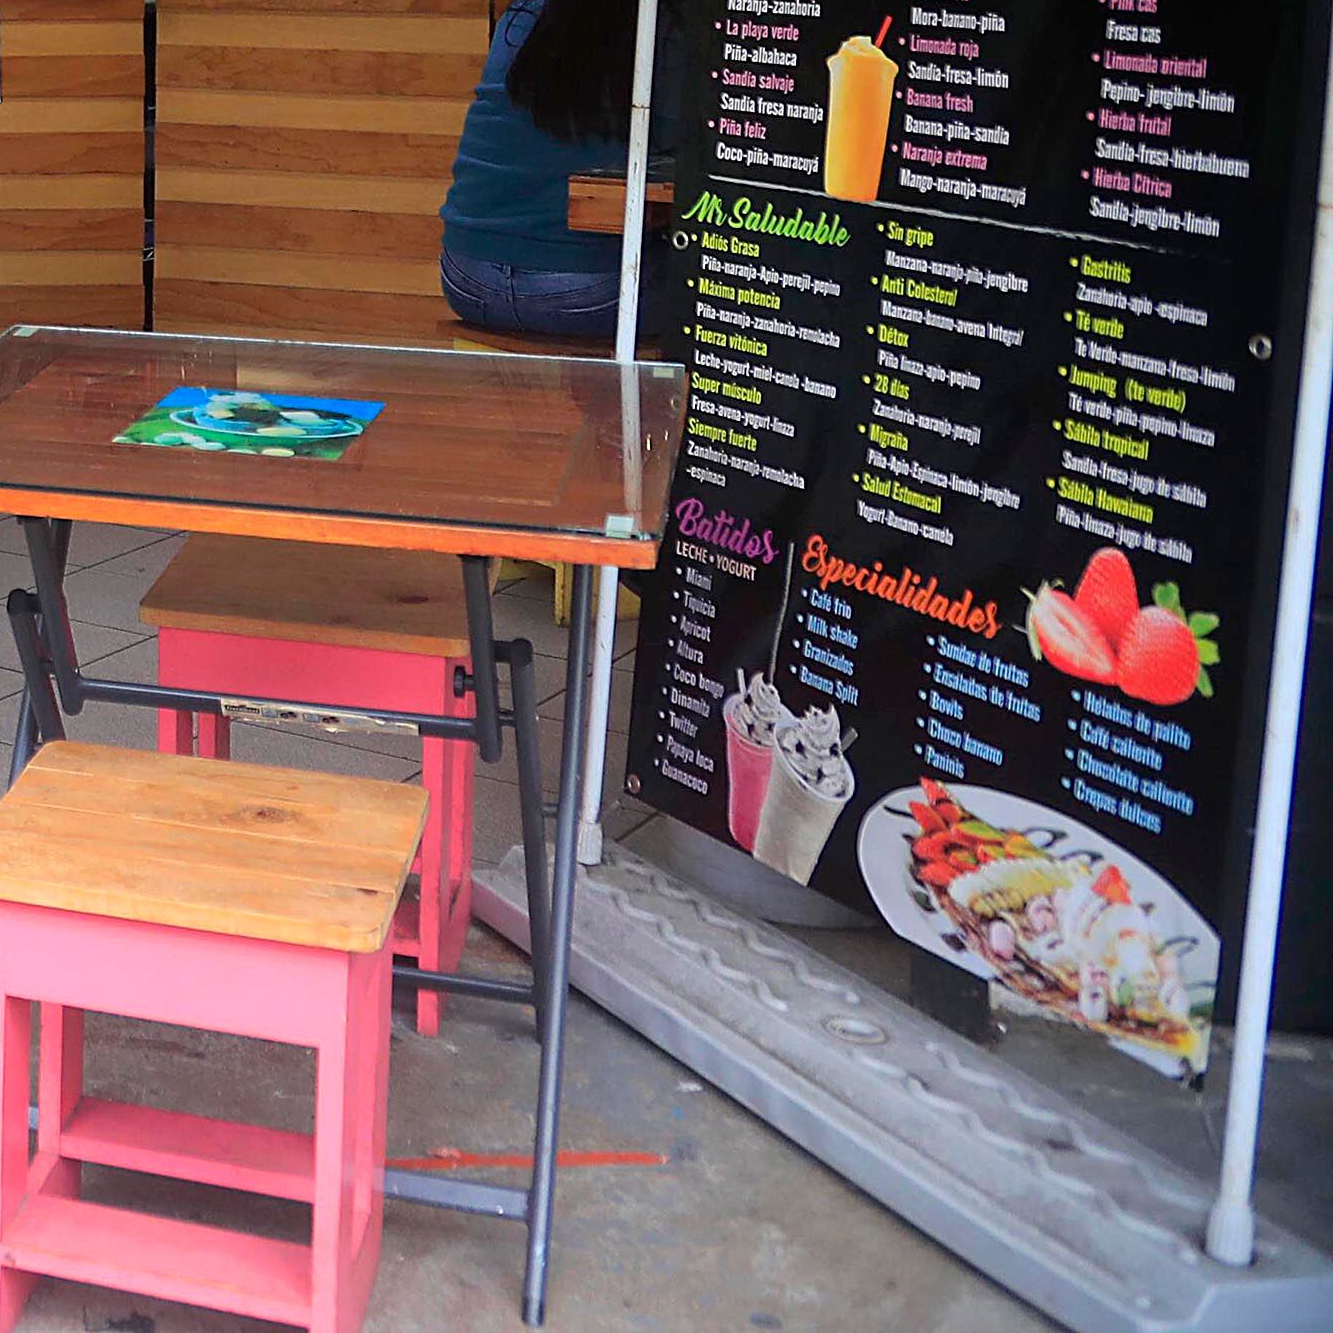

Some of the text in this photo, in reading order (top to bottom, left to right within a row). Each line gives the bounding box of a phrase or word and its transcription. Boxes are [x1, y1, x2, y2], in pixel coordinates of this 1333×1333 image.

[726, 19, 799, 43] La playa verde
[724, 42, 798, 67] Piña-albahaca
[720, 118, 767, 140] Piña feliz
[682, 191, 851, 248] Mr Saludable
[702, 232, 760, 258] Adiós Grasa
[699, 277, 781, 310] Máxima potencia
[675, 497, 779, 564] Batidos
[676, 540, 757, 582] LECHE YOGURT
[801, 534, 1003, 640] Especialidades
[803, 639, 855, 677] Granizados
